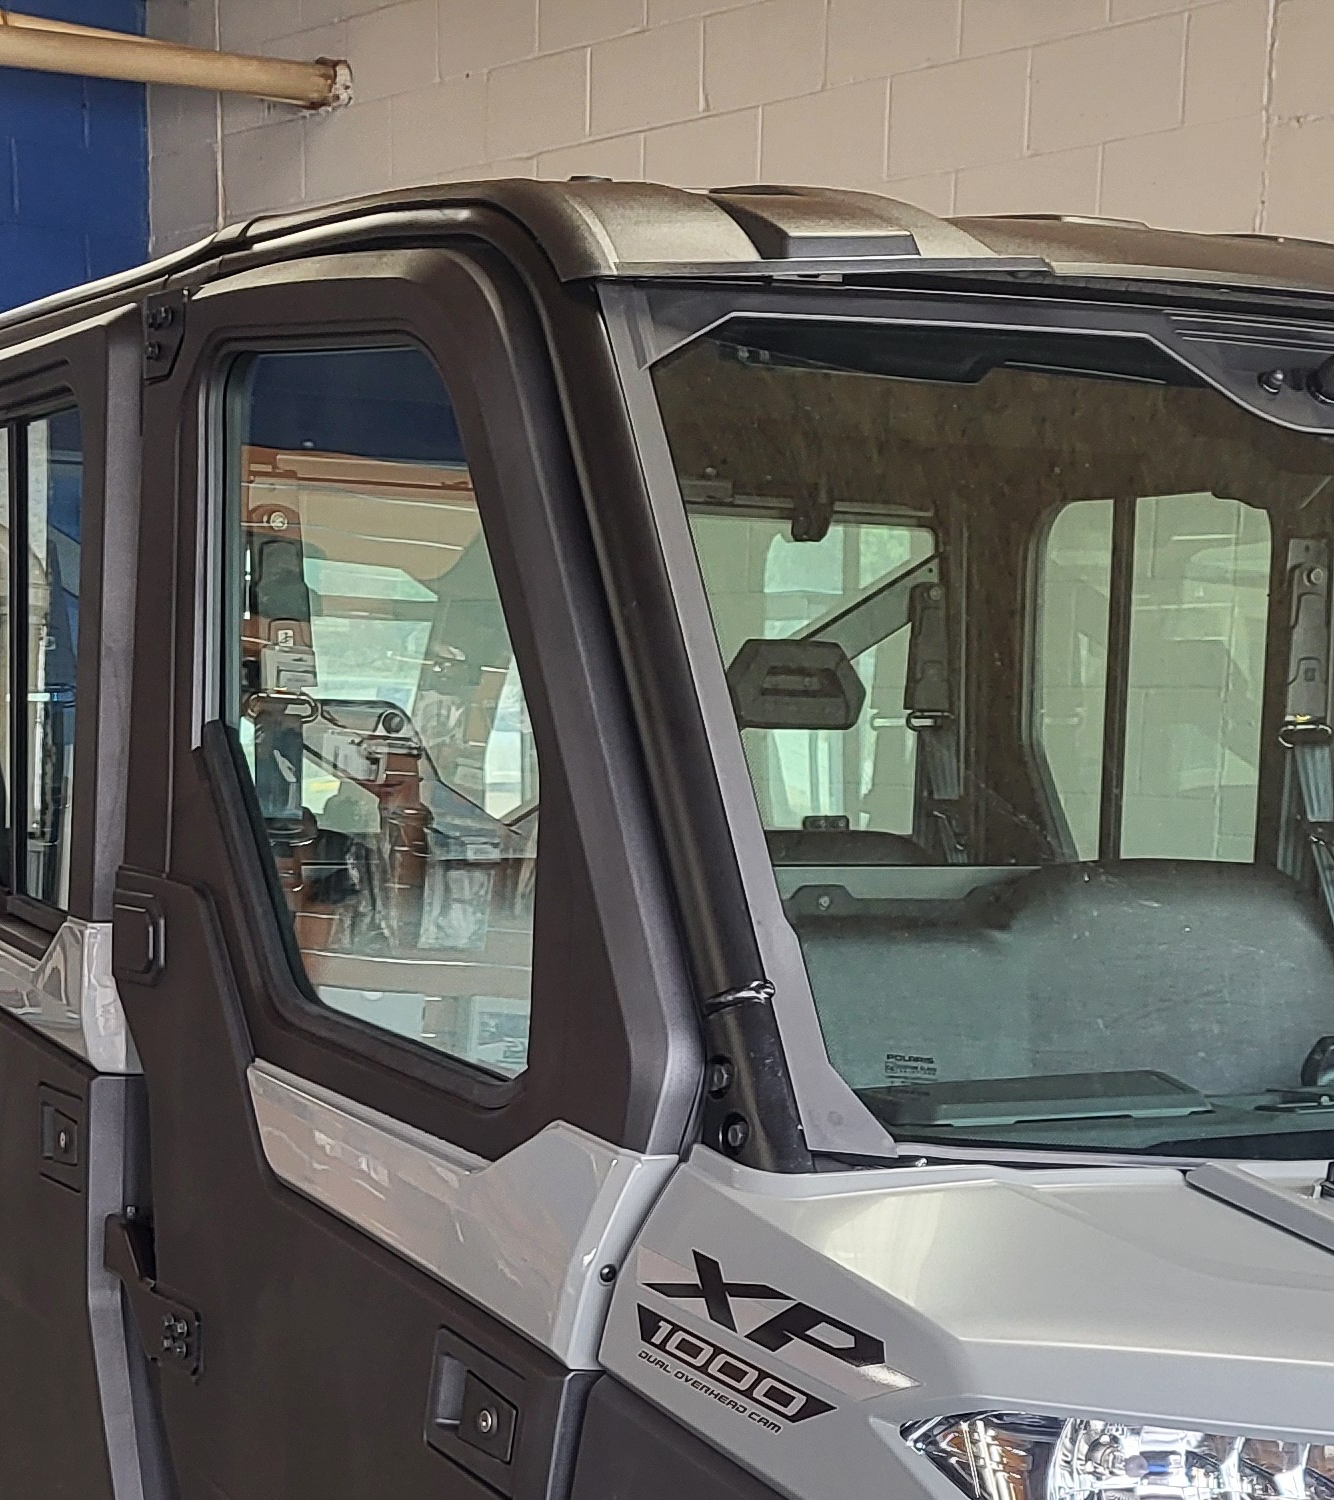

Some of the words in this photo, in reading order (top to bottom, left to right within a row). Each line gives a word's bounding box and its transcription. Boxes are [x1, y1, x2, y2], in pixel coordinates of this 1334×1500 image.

[640, 1249, 886, 1368] XP
[637, 1350, 672, 1374] DUAL
[673, 1370, 748, 1414] OVERHEAD
[747, 1411, 783, 1434] CAM
[650, 1319, 808, 1418] 1000
